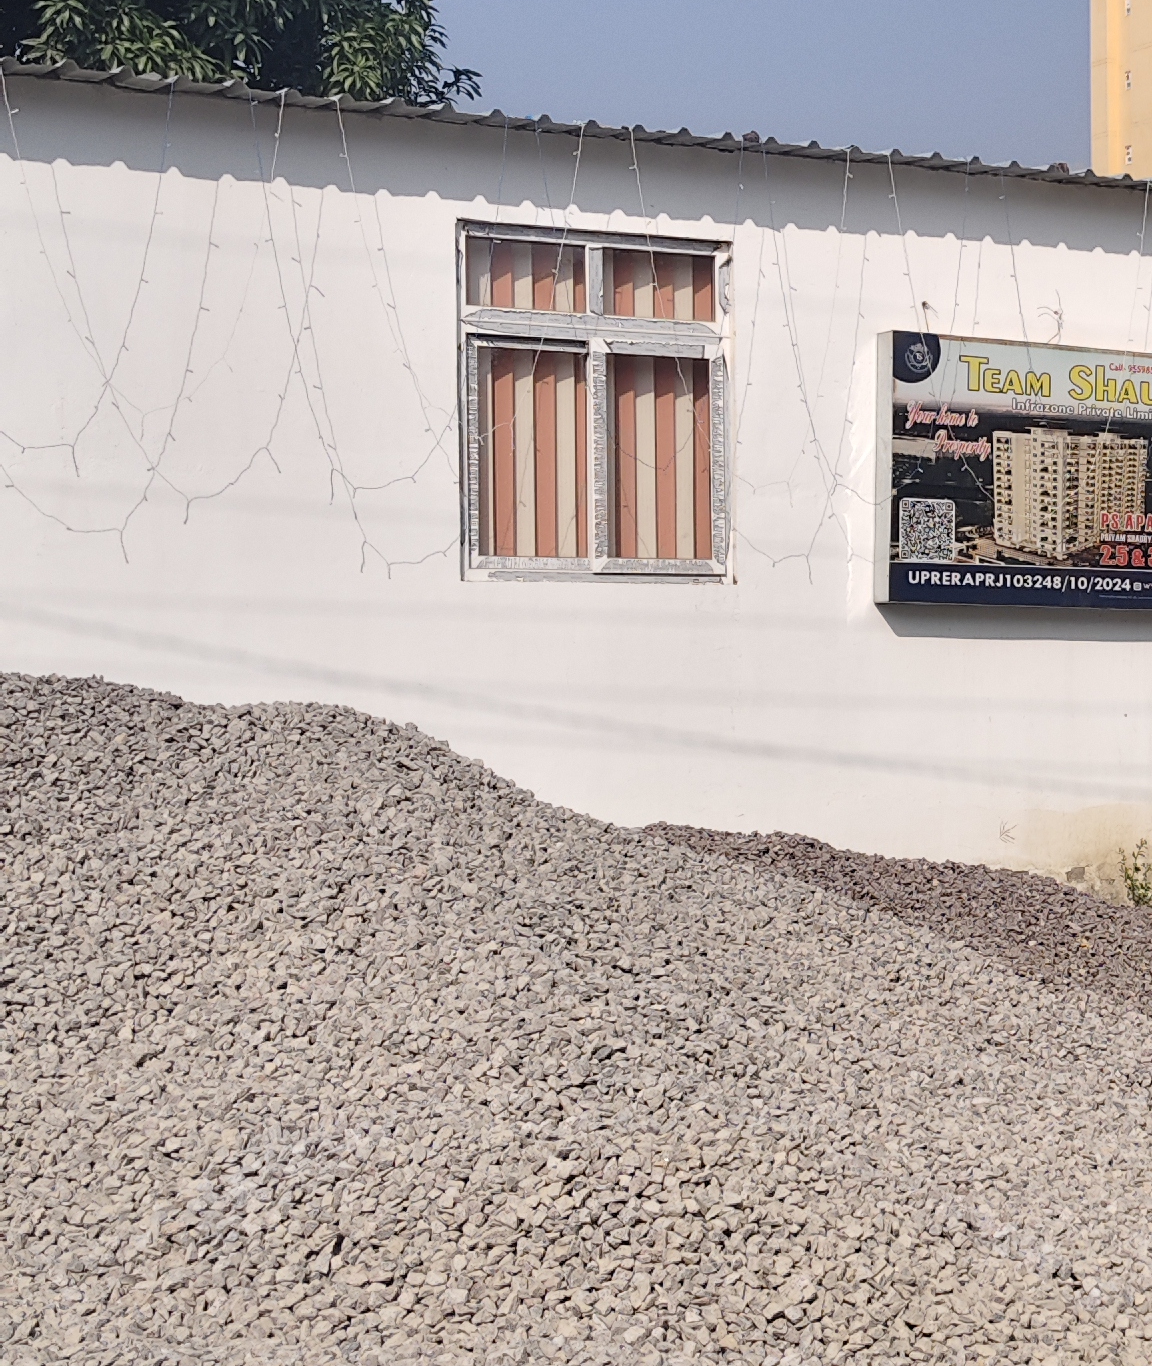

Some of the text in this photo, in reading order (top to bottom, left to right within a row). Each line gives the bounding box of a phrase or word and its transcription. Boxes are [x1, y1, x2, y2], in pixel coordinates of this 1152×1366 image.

[959, 355, 1051, 397] TEAM
[905, 400, 937, 429] Your
[967, 409, 978, 427] to
[1012, 397, 1074, 415] Infrazone
[1078, 403, 1122, 418] Private
[933, 429, 992, 462] Prosperity
[1099, 512, 1120, 531] PS
[1099, 544, 1129, 566] 2.5
[1131, 549, 1145, 566] &
[908, 570, 1131, 593] UPRERAPRJ103248/10/2024
